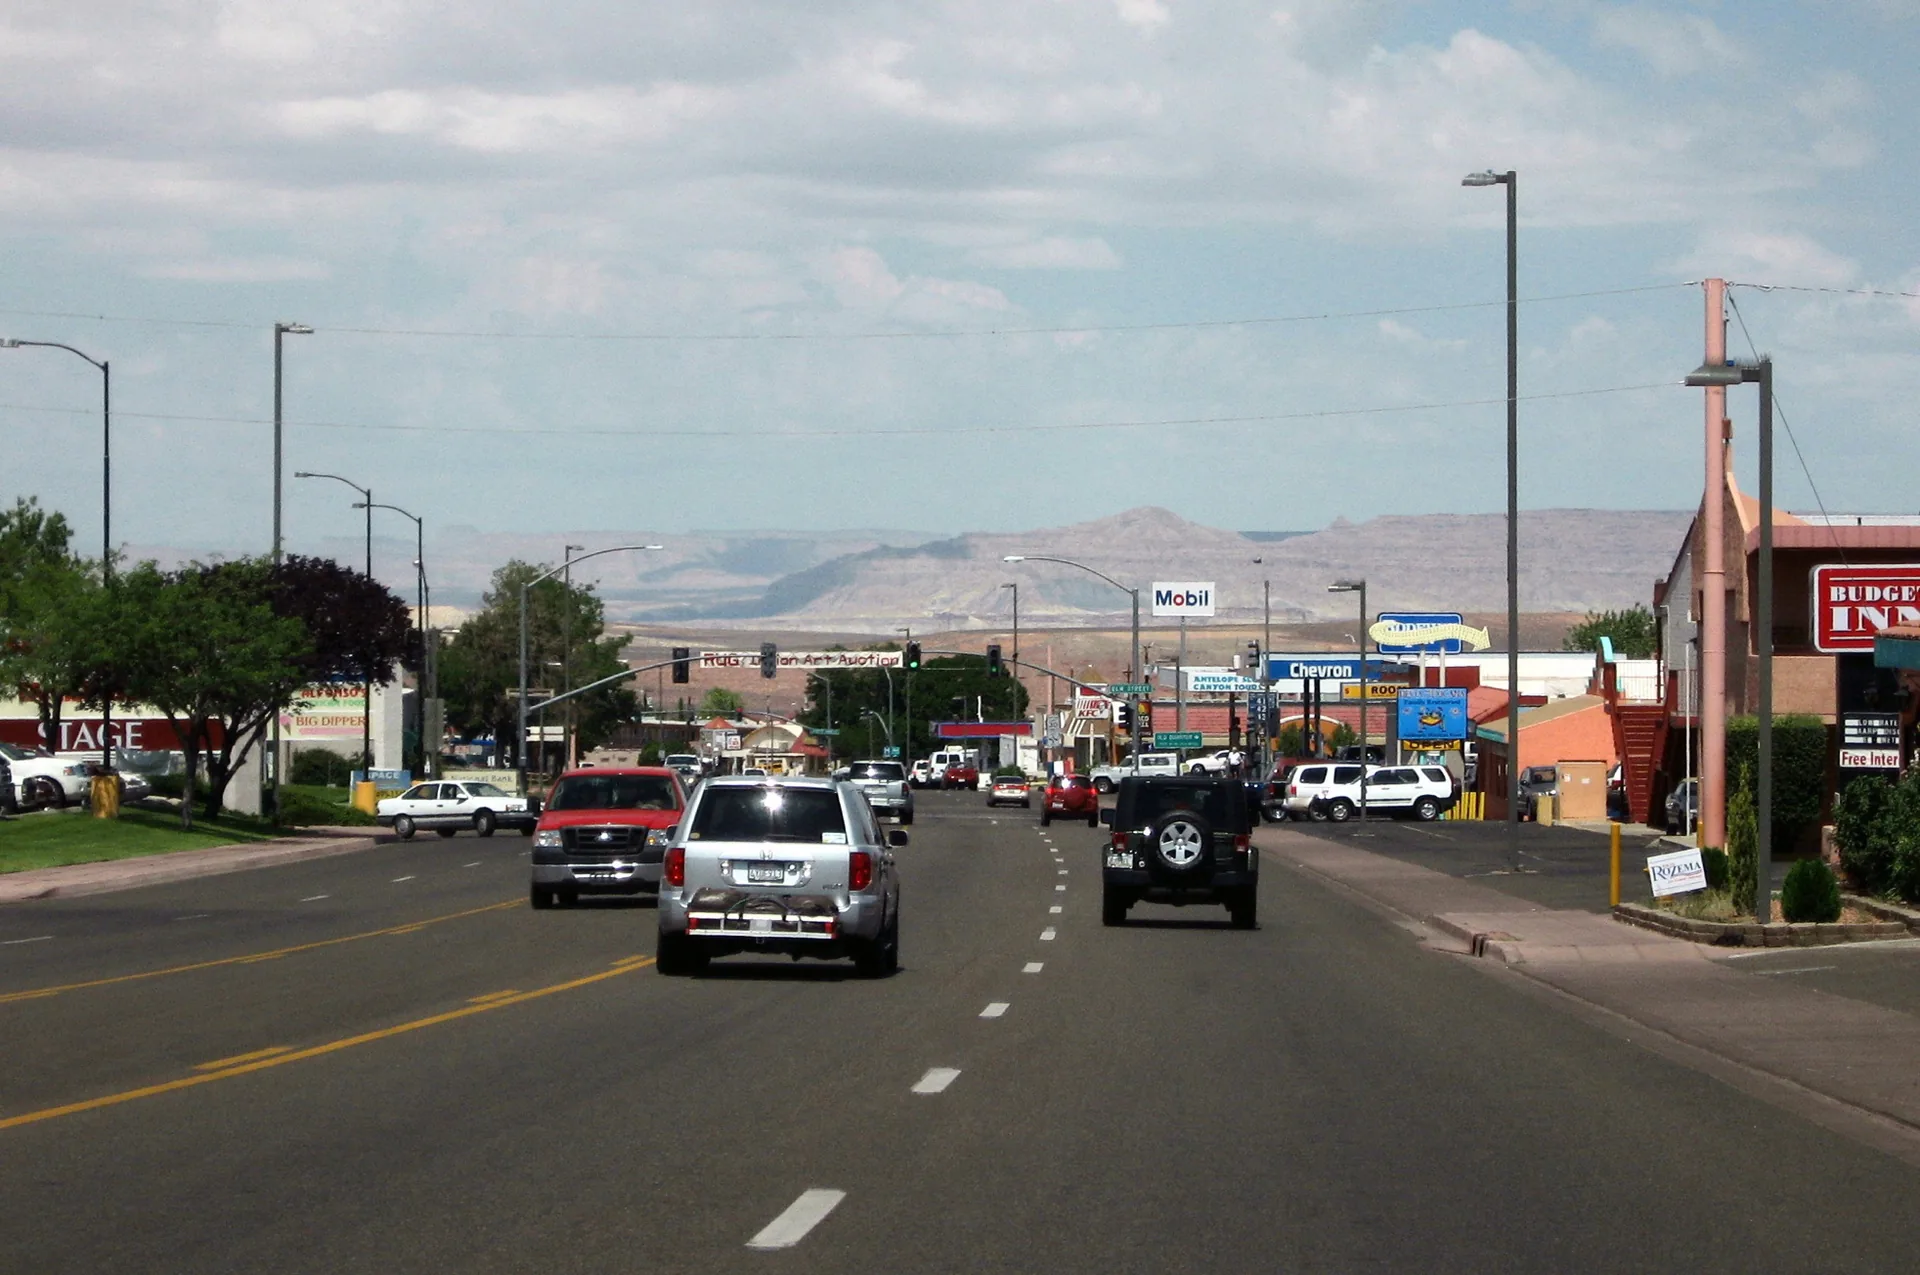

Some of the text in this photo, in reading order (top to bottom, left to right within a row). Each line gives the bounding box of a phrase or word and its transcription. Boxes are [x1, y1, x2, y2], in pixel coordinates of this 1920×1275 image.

[1155, 590, 1209, 606] Mobil
[1829, 585, 1920, 602] BUDGE
[703, 653, 740, 666] RUG
[803, 654, 832, 666] Art
[839, 653, 899, 666] Auction
[1290, 662, 1352, 678] Chevron
[1371, 686, 1407, 695] ROO
[296, 716, 367, 726] BIG DIPPER
[37, 721, 143, 750] STAGE
[1409, 740, 1455, 749] OPEN
[1842, 751, 1898, 766] Free Inter
[491, 774, 513, 783] Bank
